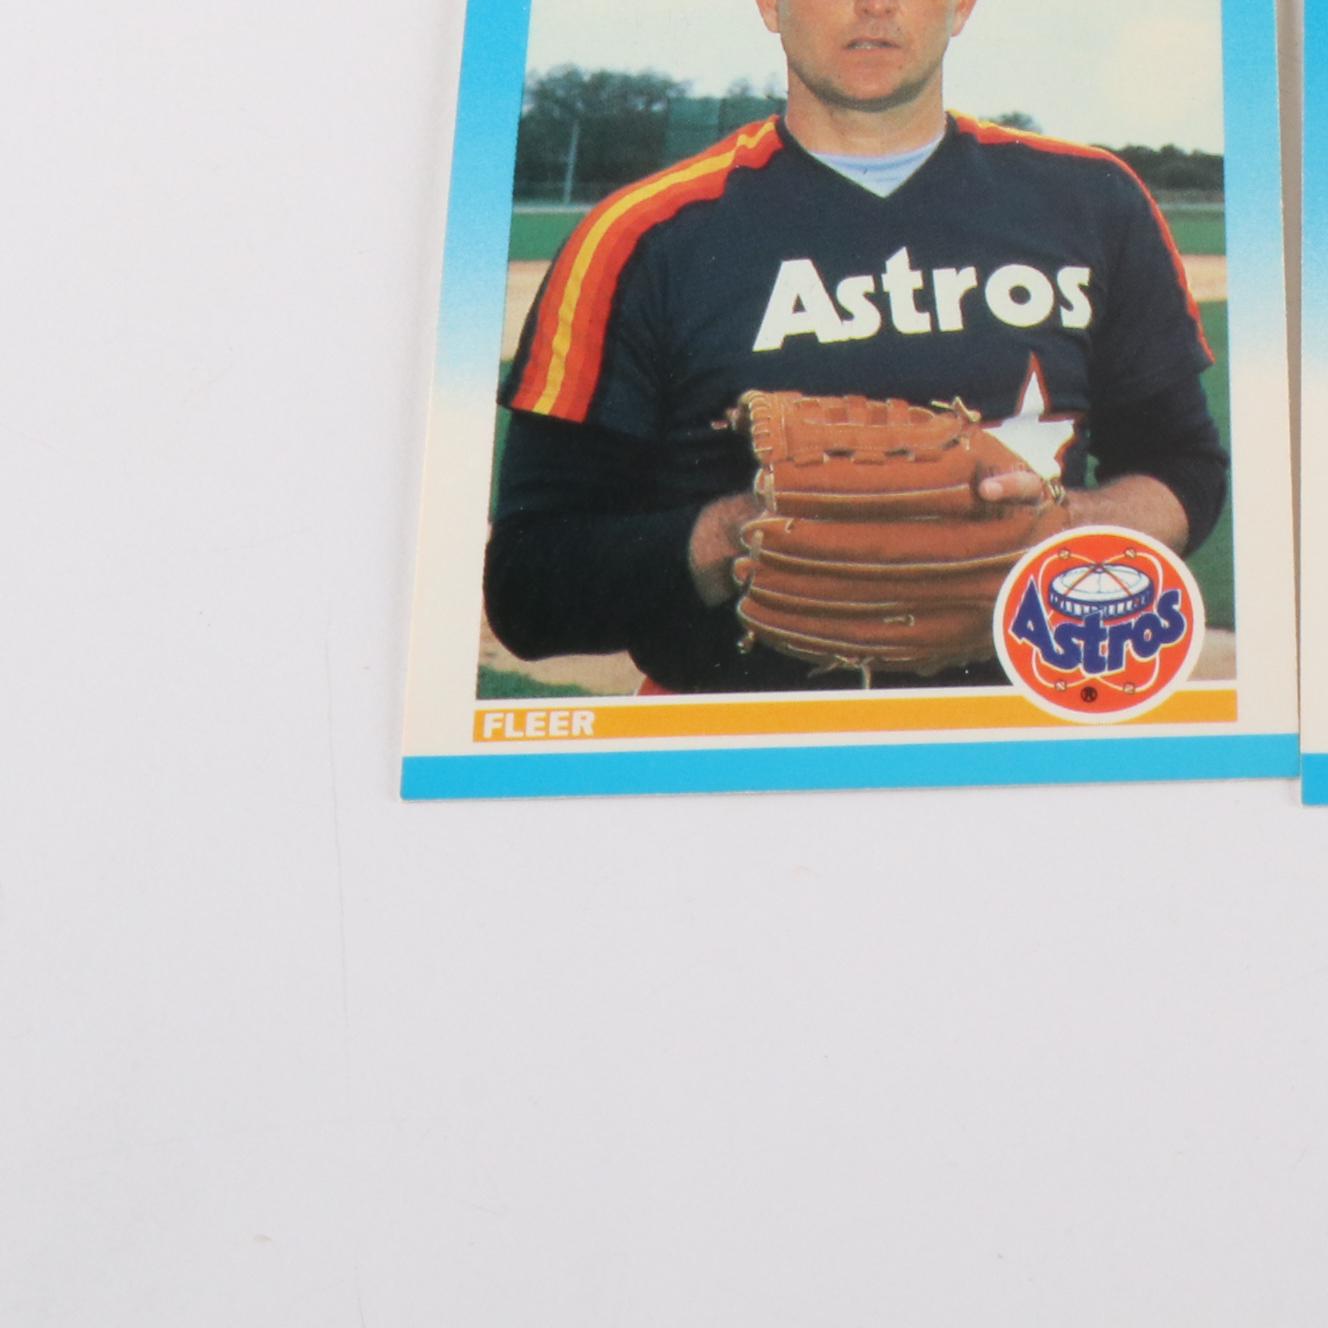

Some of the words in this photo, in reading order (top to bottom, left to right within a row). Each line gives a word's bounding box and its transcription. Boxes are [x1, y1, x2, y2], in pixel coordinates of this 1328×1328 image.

[752, 247, 1093, 352] Astros
[1008, 574, 1188, 678] Astros
[483, 709, 594, 739] FLEER
